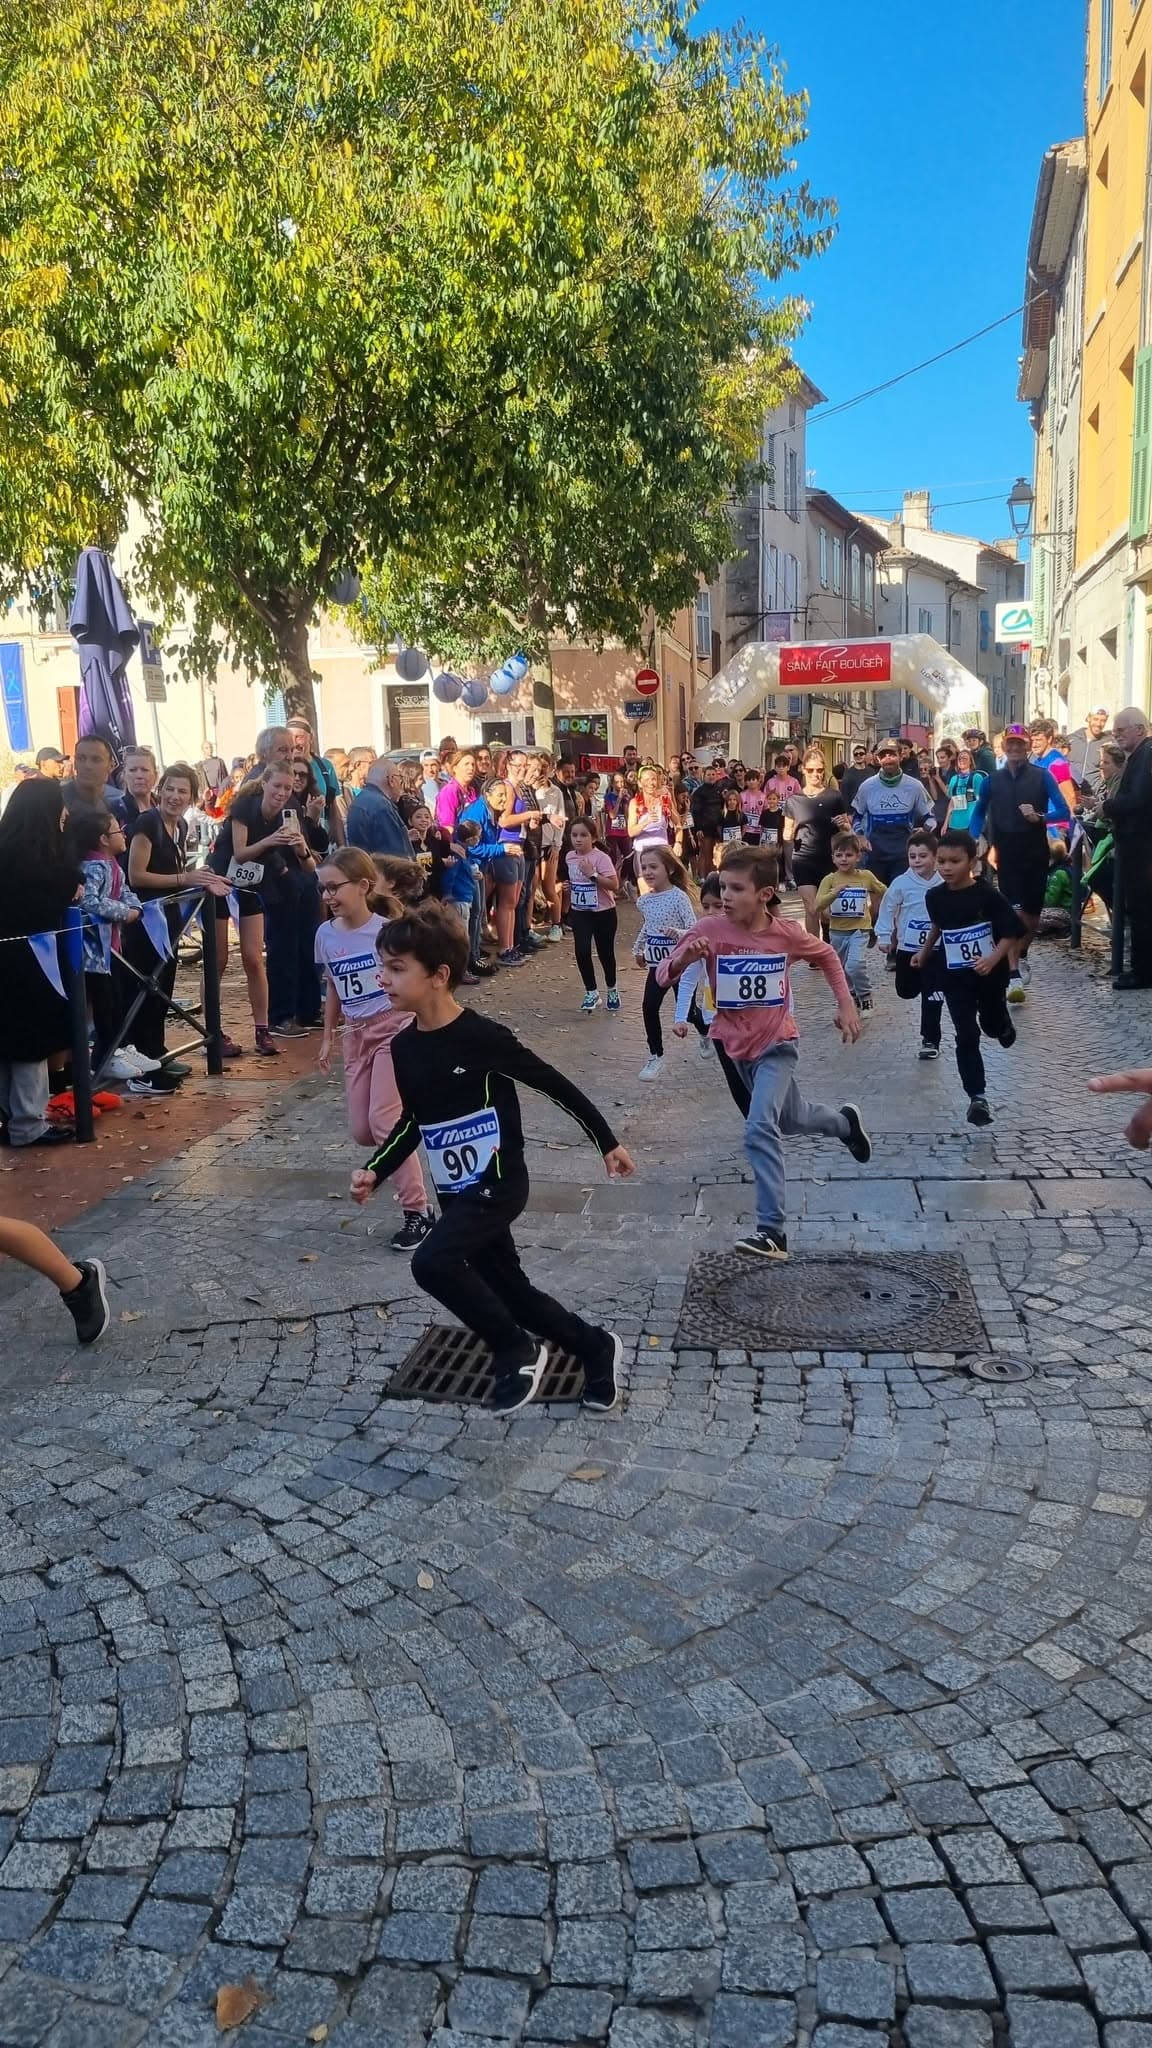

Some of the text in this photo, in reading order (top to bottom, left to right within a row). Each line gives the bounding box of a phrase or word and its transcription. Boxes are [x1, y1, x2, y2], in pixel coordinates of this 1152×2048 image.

[815, 659, 839, 670] FAIT
[840, 657, 883, 669] BOUGER
[235, 867, 255, 881] 639
[574, 892, 586, 905] 74
[841, 898, 857, 912] 94
[647, 946, 670, 961] 100
[960, 940, 982, 961] 84
[338, 972, 363, 998] 75
[738, 975, 767, 1000] 88
[778, 980, 785, 997] 3
[442, 1144, 479, 1181] 90
